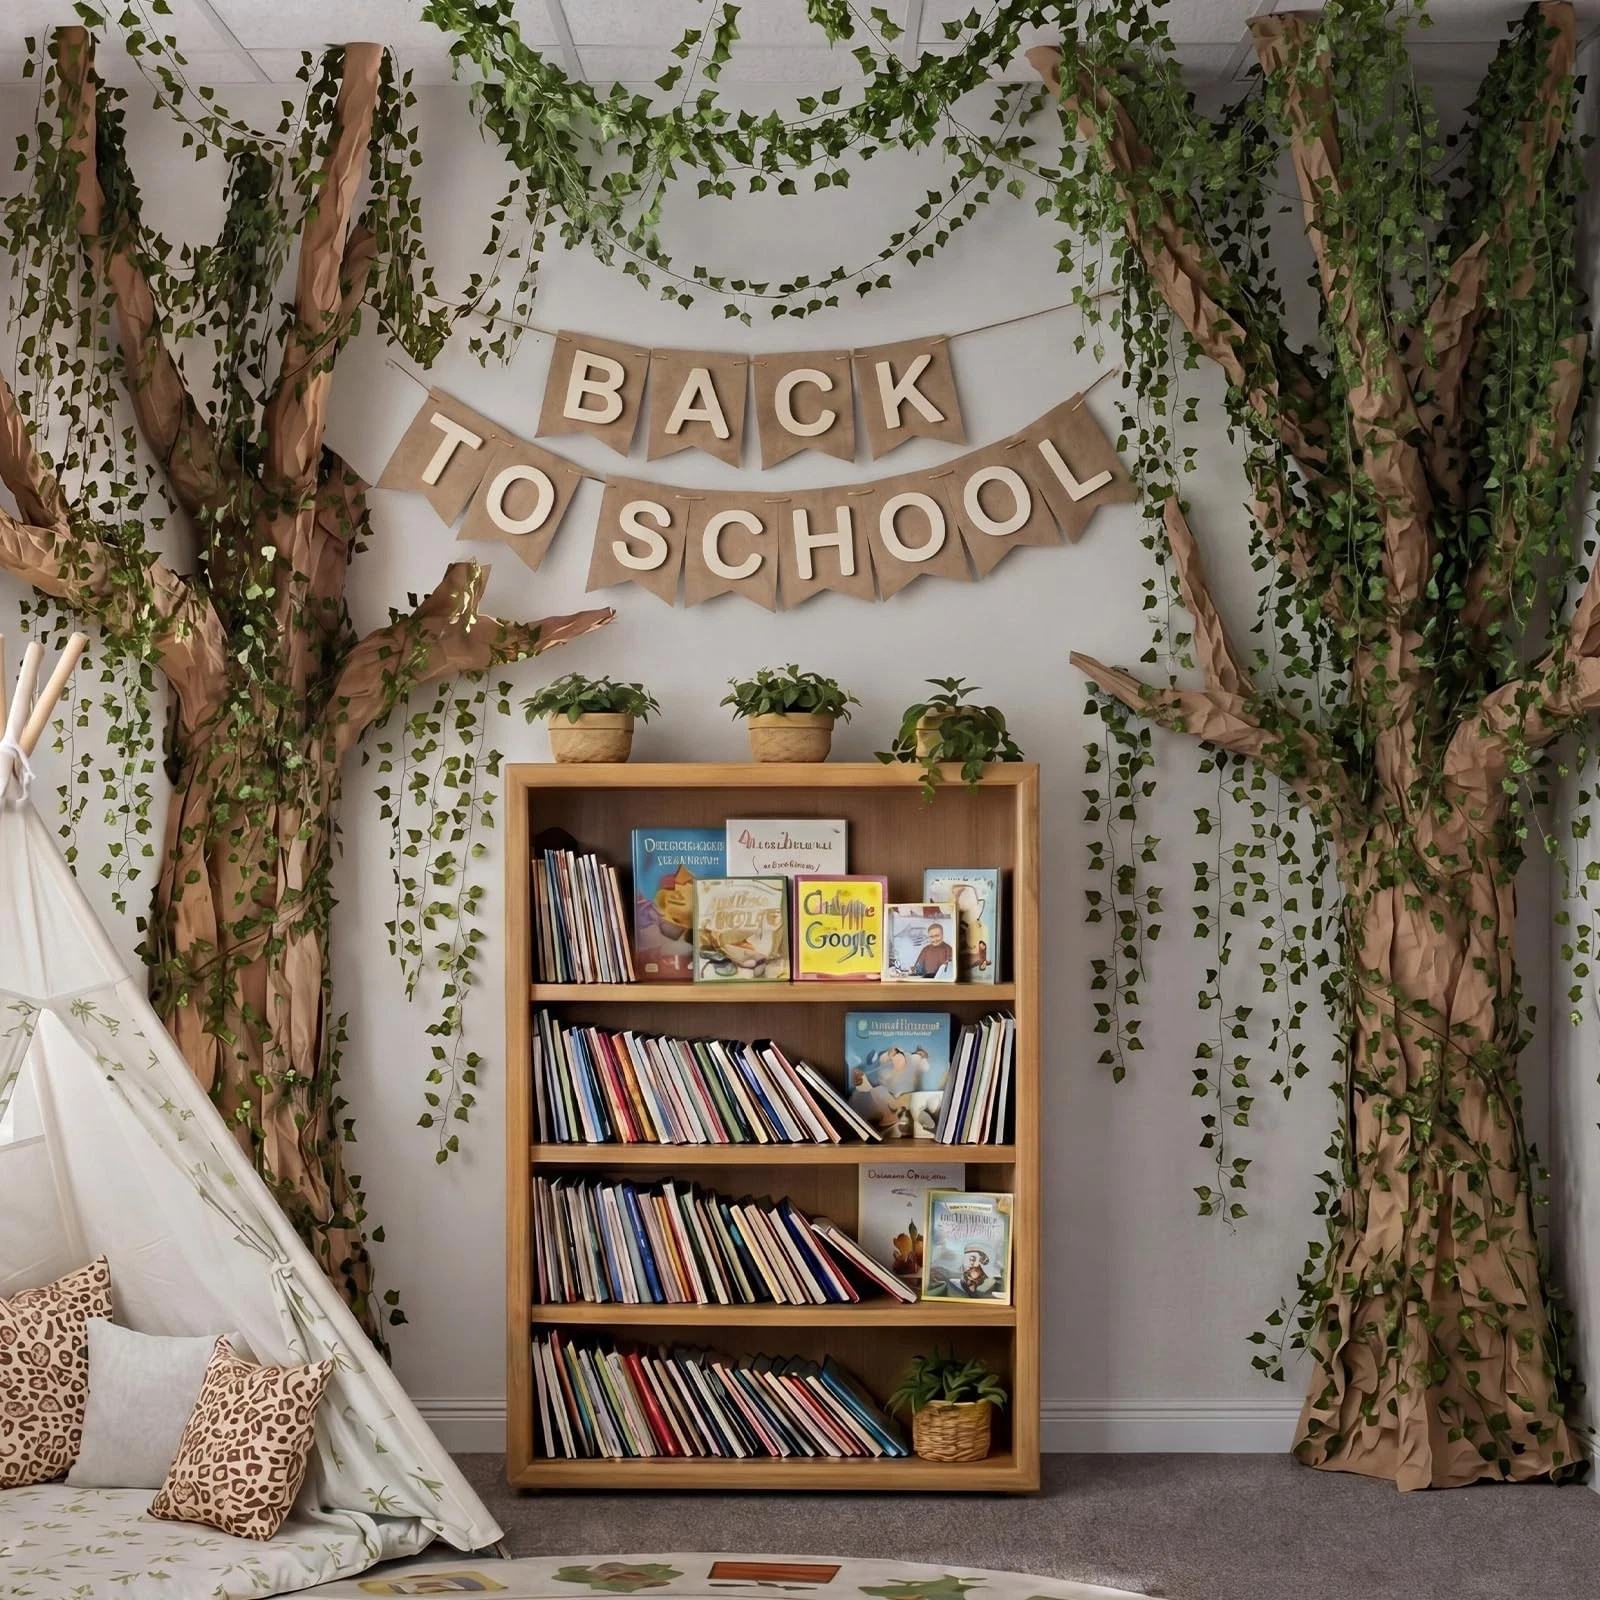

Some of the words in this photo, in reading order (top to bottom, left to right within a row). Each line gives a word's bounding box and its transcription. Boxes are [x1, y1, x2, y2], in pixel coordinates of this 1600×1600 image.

[563, 349, 946, 440] BACK
[420, 411, 556, 536] TO
[611, 437, 1115, 581] SCHOOL
